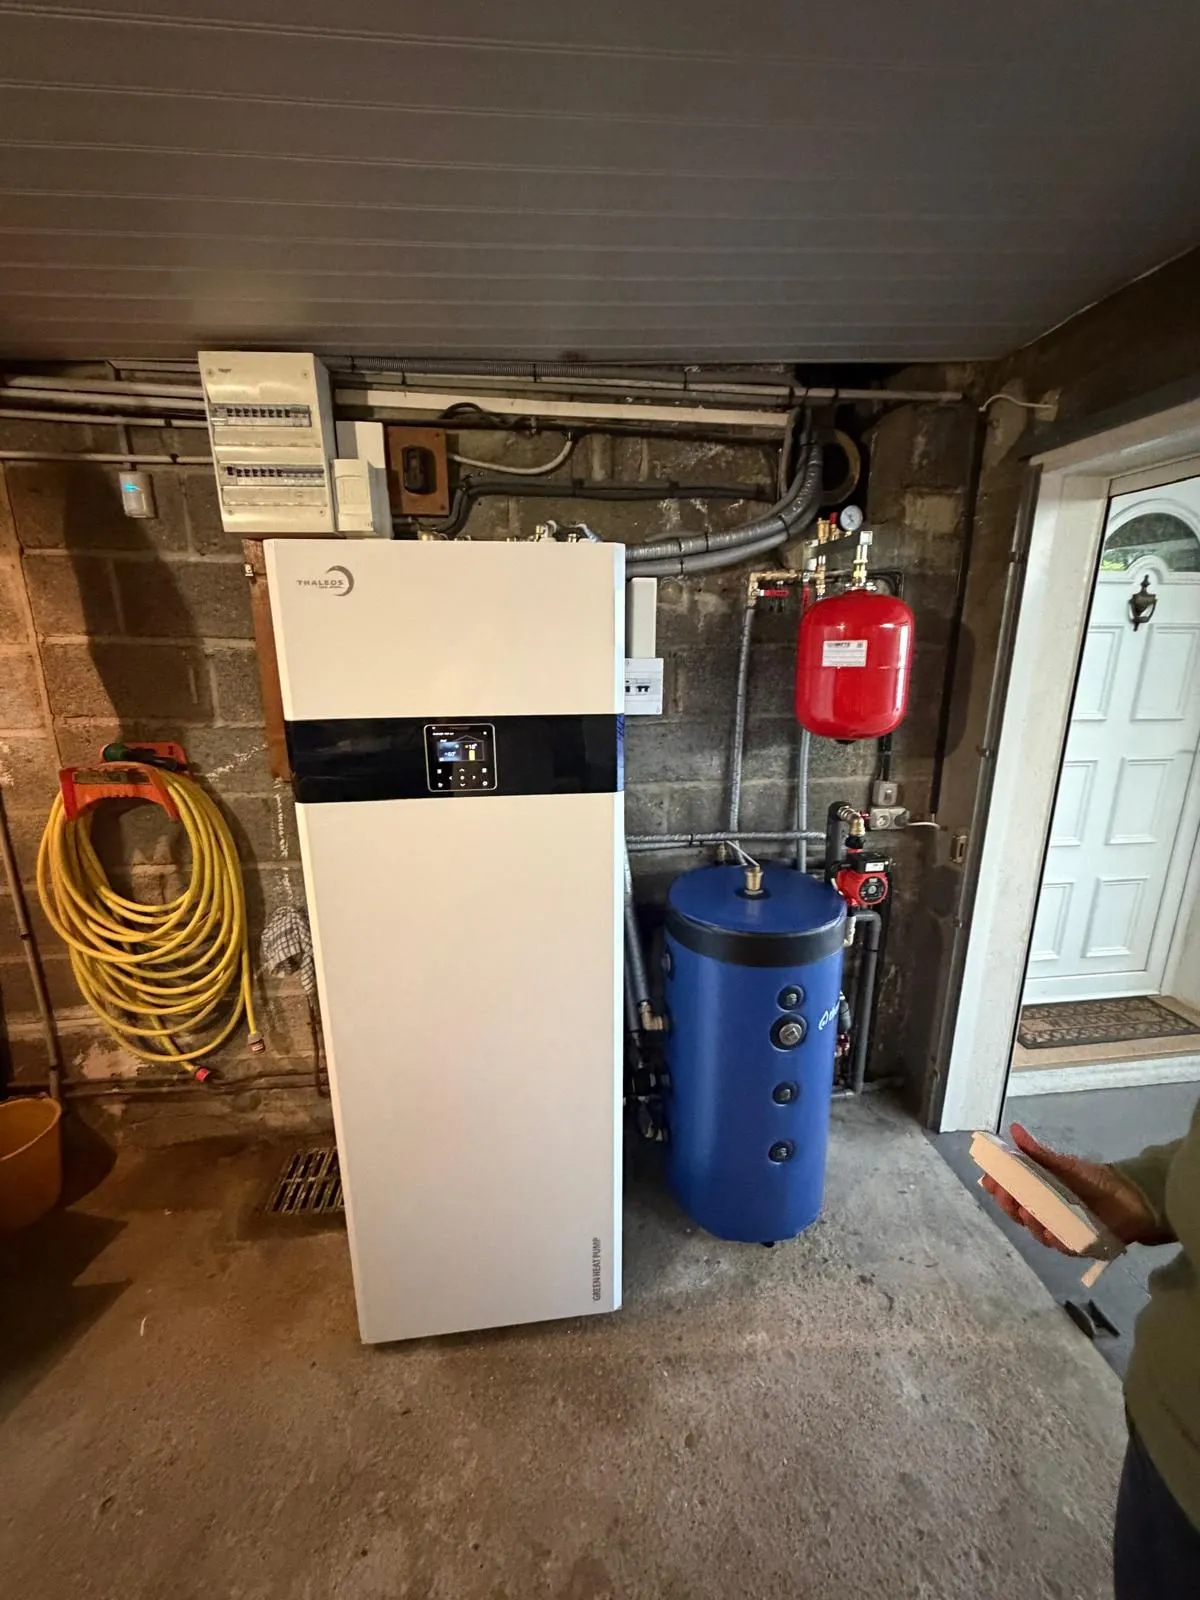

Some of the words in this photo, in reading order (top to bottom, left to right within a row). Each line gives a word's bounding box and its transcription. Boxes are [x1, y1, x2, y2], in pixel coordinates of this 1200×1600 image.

[592, 1237, 601, 1258] PUMP
[592, 1259, 601, 1277] HEAT
[592, 1277, 601, 1301] GREEN
